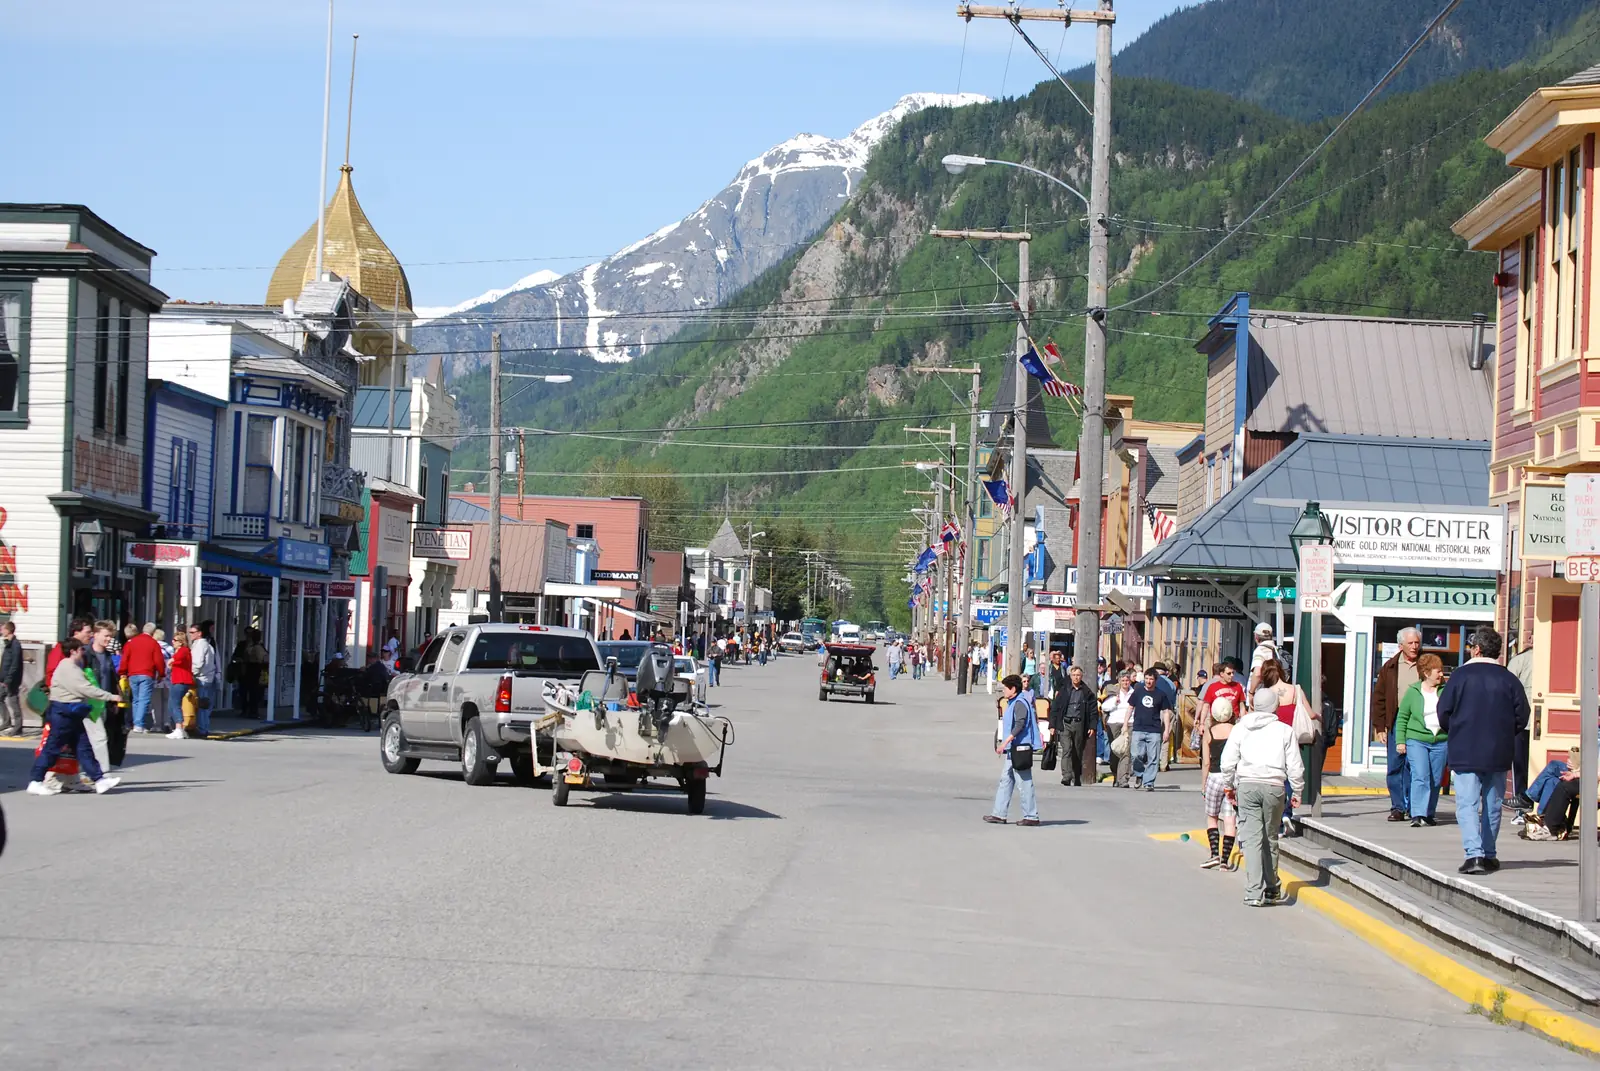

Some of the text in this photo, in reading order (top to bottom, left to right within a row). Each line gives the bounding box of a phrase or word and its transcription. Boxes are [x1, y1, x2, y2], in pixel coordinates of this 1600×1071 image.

[1325, 513, 1491, 540] VISITOR CENTER
[417, 532, 468, 547] VENETIAN
[1332, 540, 1491, 555] ONDIKE GOLD RUSH NATIONAL HISTORICAL PARK
[1568, 561, 1600, 576] BEG
[1164, 585, 1225, 598] Diamonds
[1278, 589, 1292, 598] AVE
[1192, 601, 1241, 614] Princess
[1304, 599, 1329, 608] END
